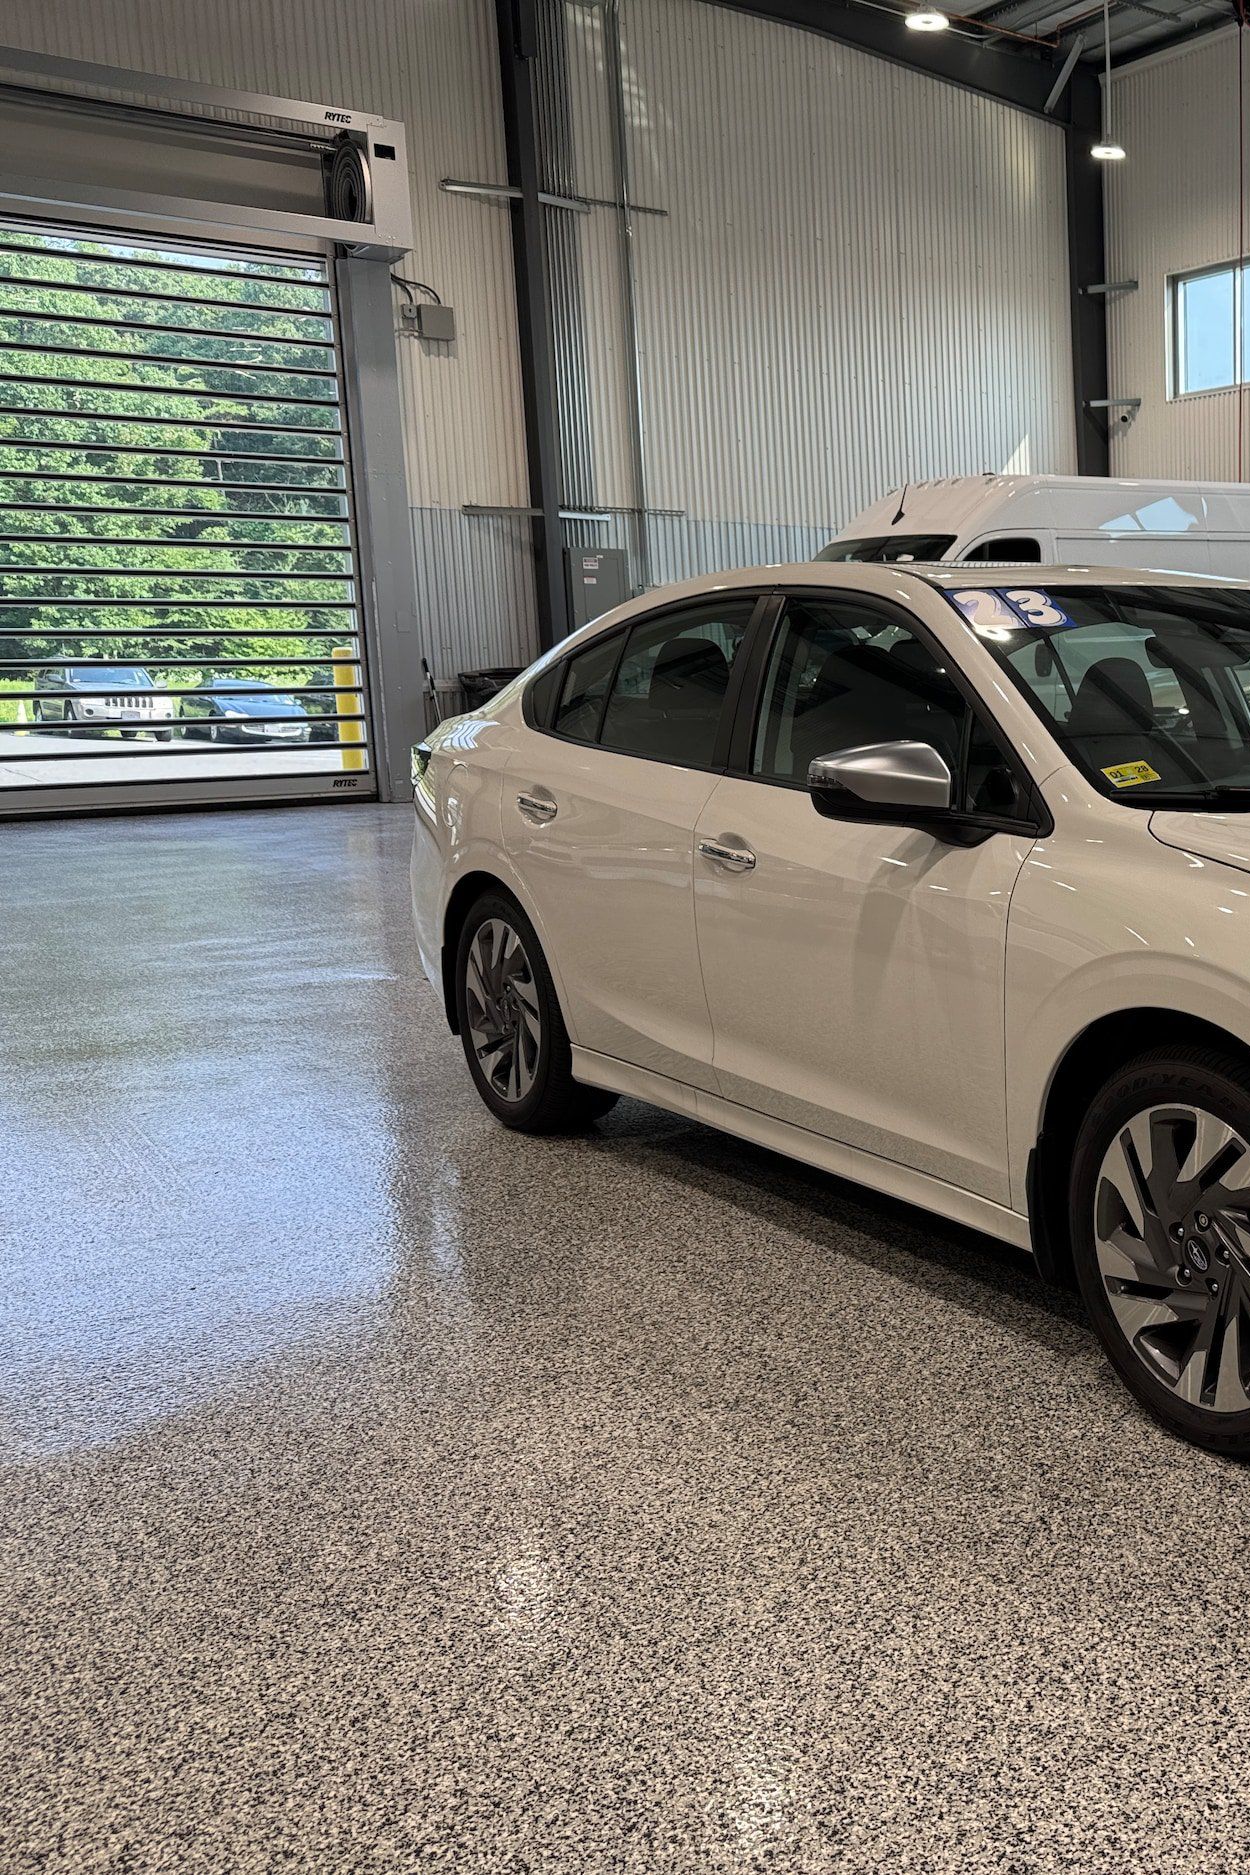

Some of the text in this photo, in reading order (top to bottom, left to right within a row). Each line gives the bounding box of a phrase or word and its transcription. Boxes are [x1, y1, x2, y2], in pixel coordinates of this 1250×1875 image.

[324, 111, 352, 124] RYTEC
[953, 590, 1068, 627] 23
[332, 778, 358, 788] RYTEC
